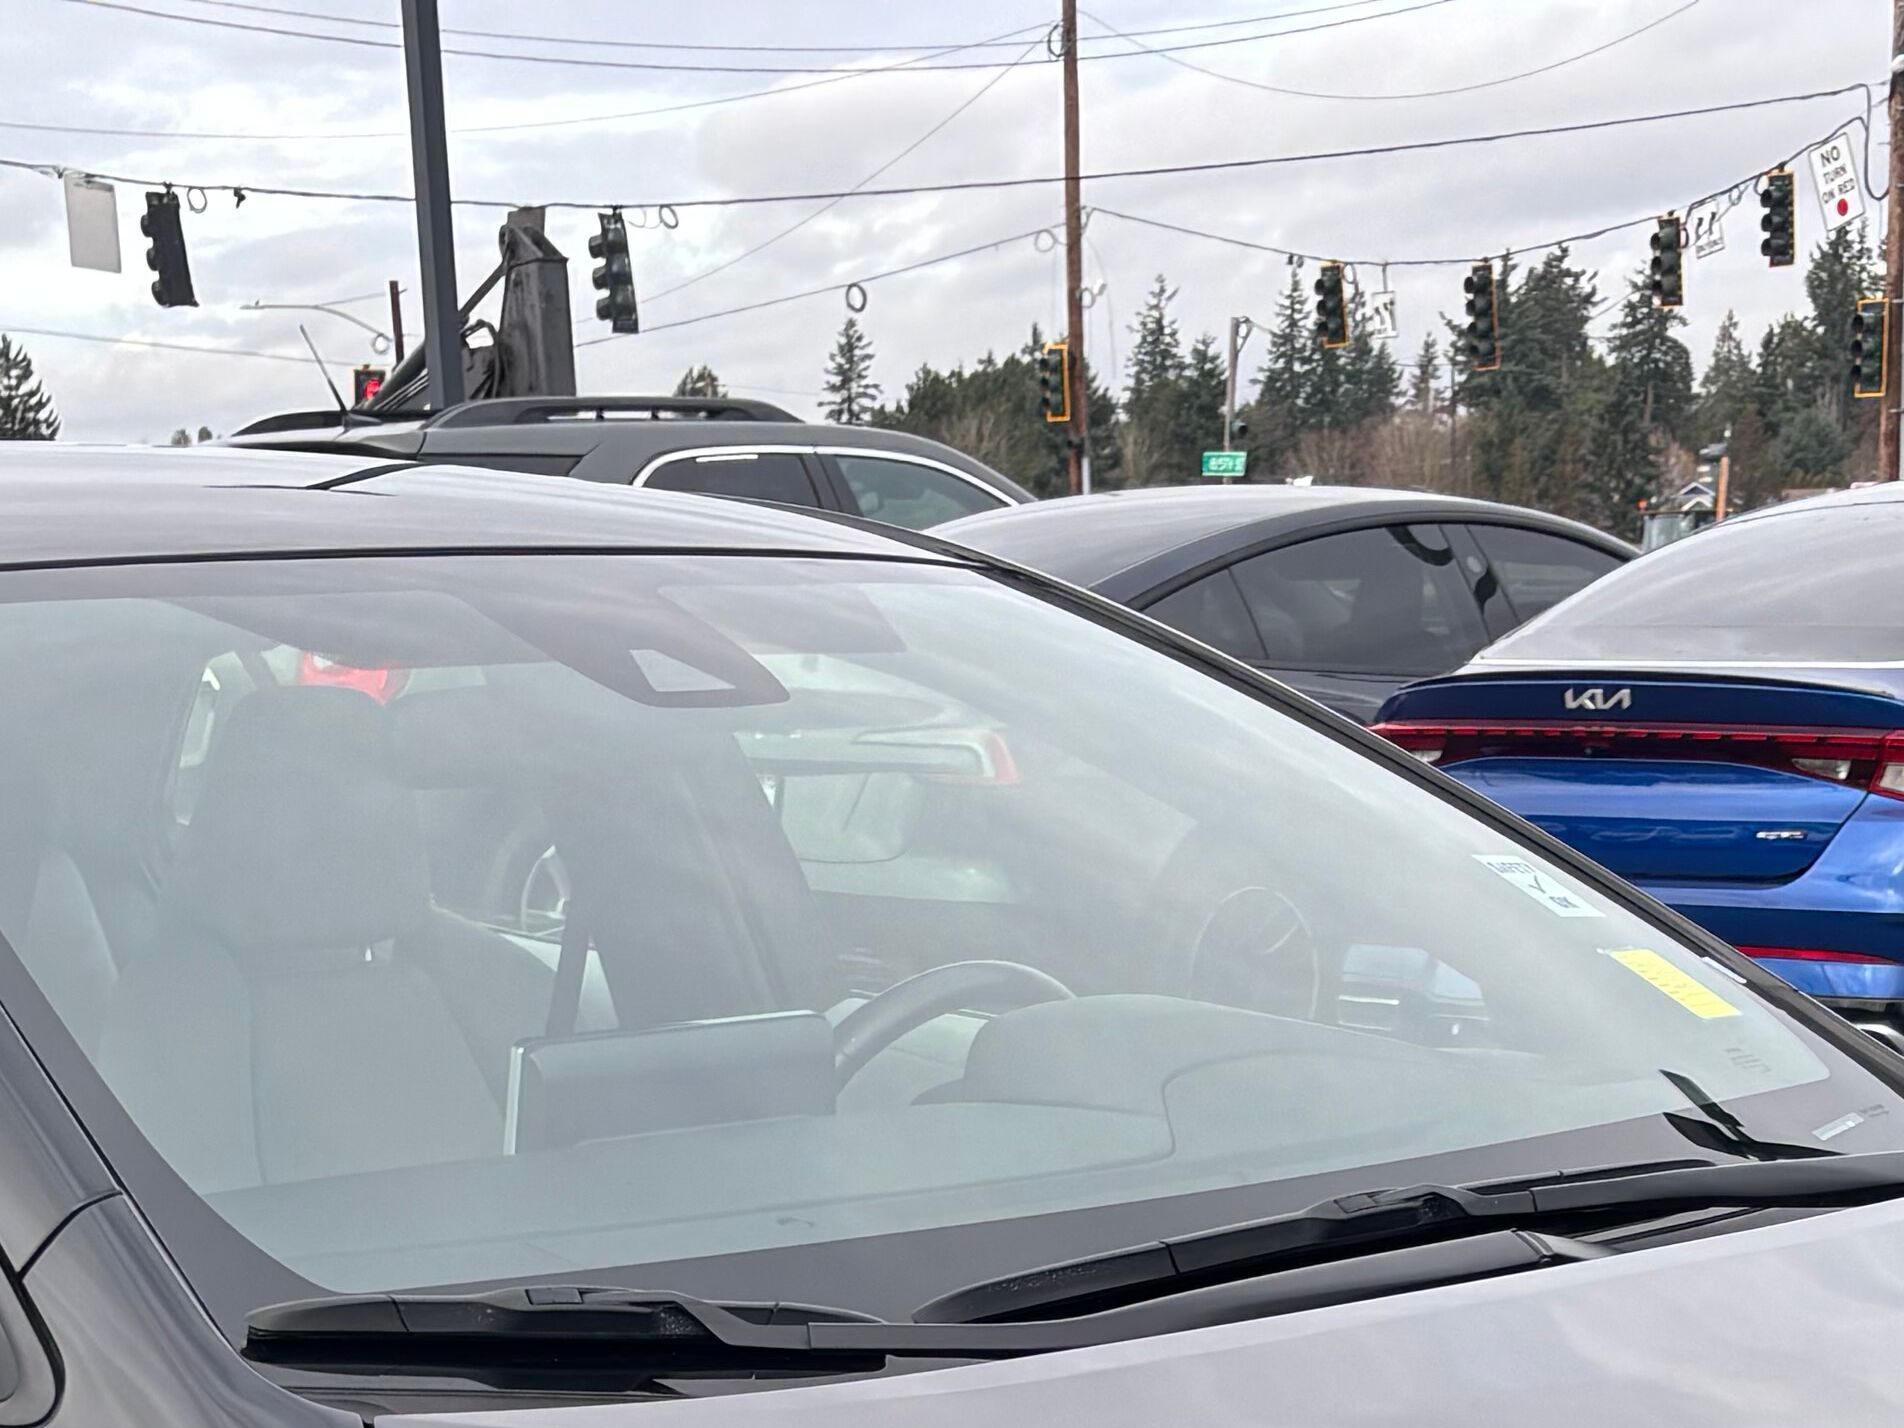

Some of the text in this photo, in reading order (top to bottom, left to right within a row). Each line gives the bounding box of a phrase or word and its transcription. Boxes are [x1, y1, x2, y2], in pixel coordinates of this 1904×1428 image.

[1820, 145, 1840, 167] NO
[1823, 164, 1847, 184] TURN
[1822, 178, 1856, 204] ON RED
[1564, 687, 1632, 710] KIA
